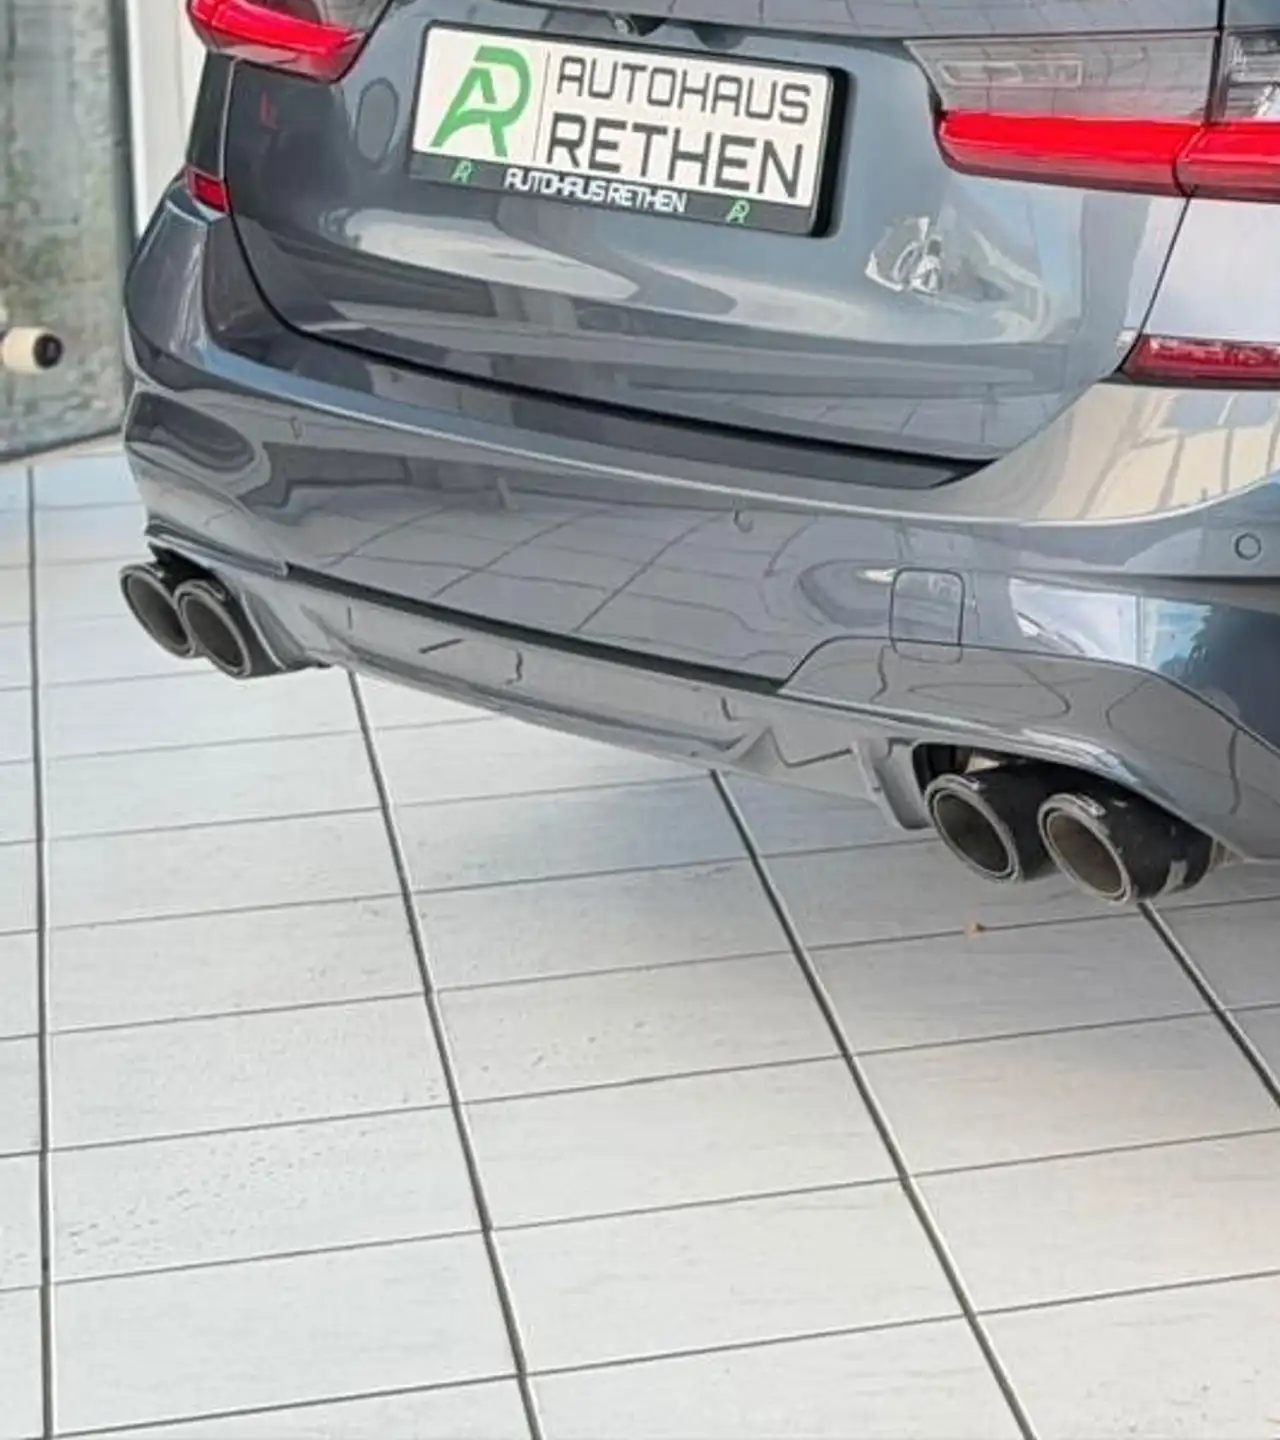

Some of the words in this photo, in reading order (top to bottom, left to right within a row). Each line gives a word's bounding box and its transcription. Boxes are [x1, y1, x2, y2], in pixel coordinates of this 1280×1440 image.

[556, 54, 812, 125] AUTOHAUS
[503, 166, 606, 202] AUTOHAUS
[607, 183, 688, 213] RETHEN
[546, 111, 804, 199] RETHEN
